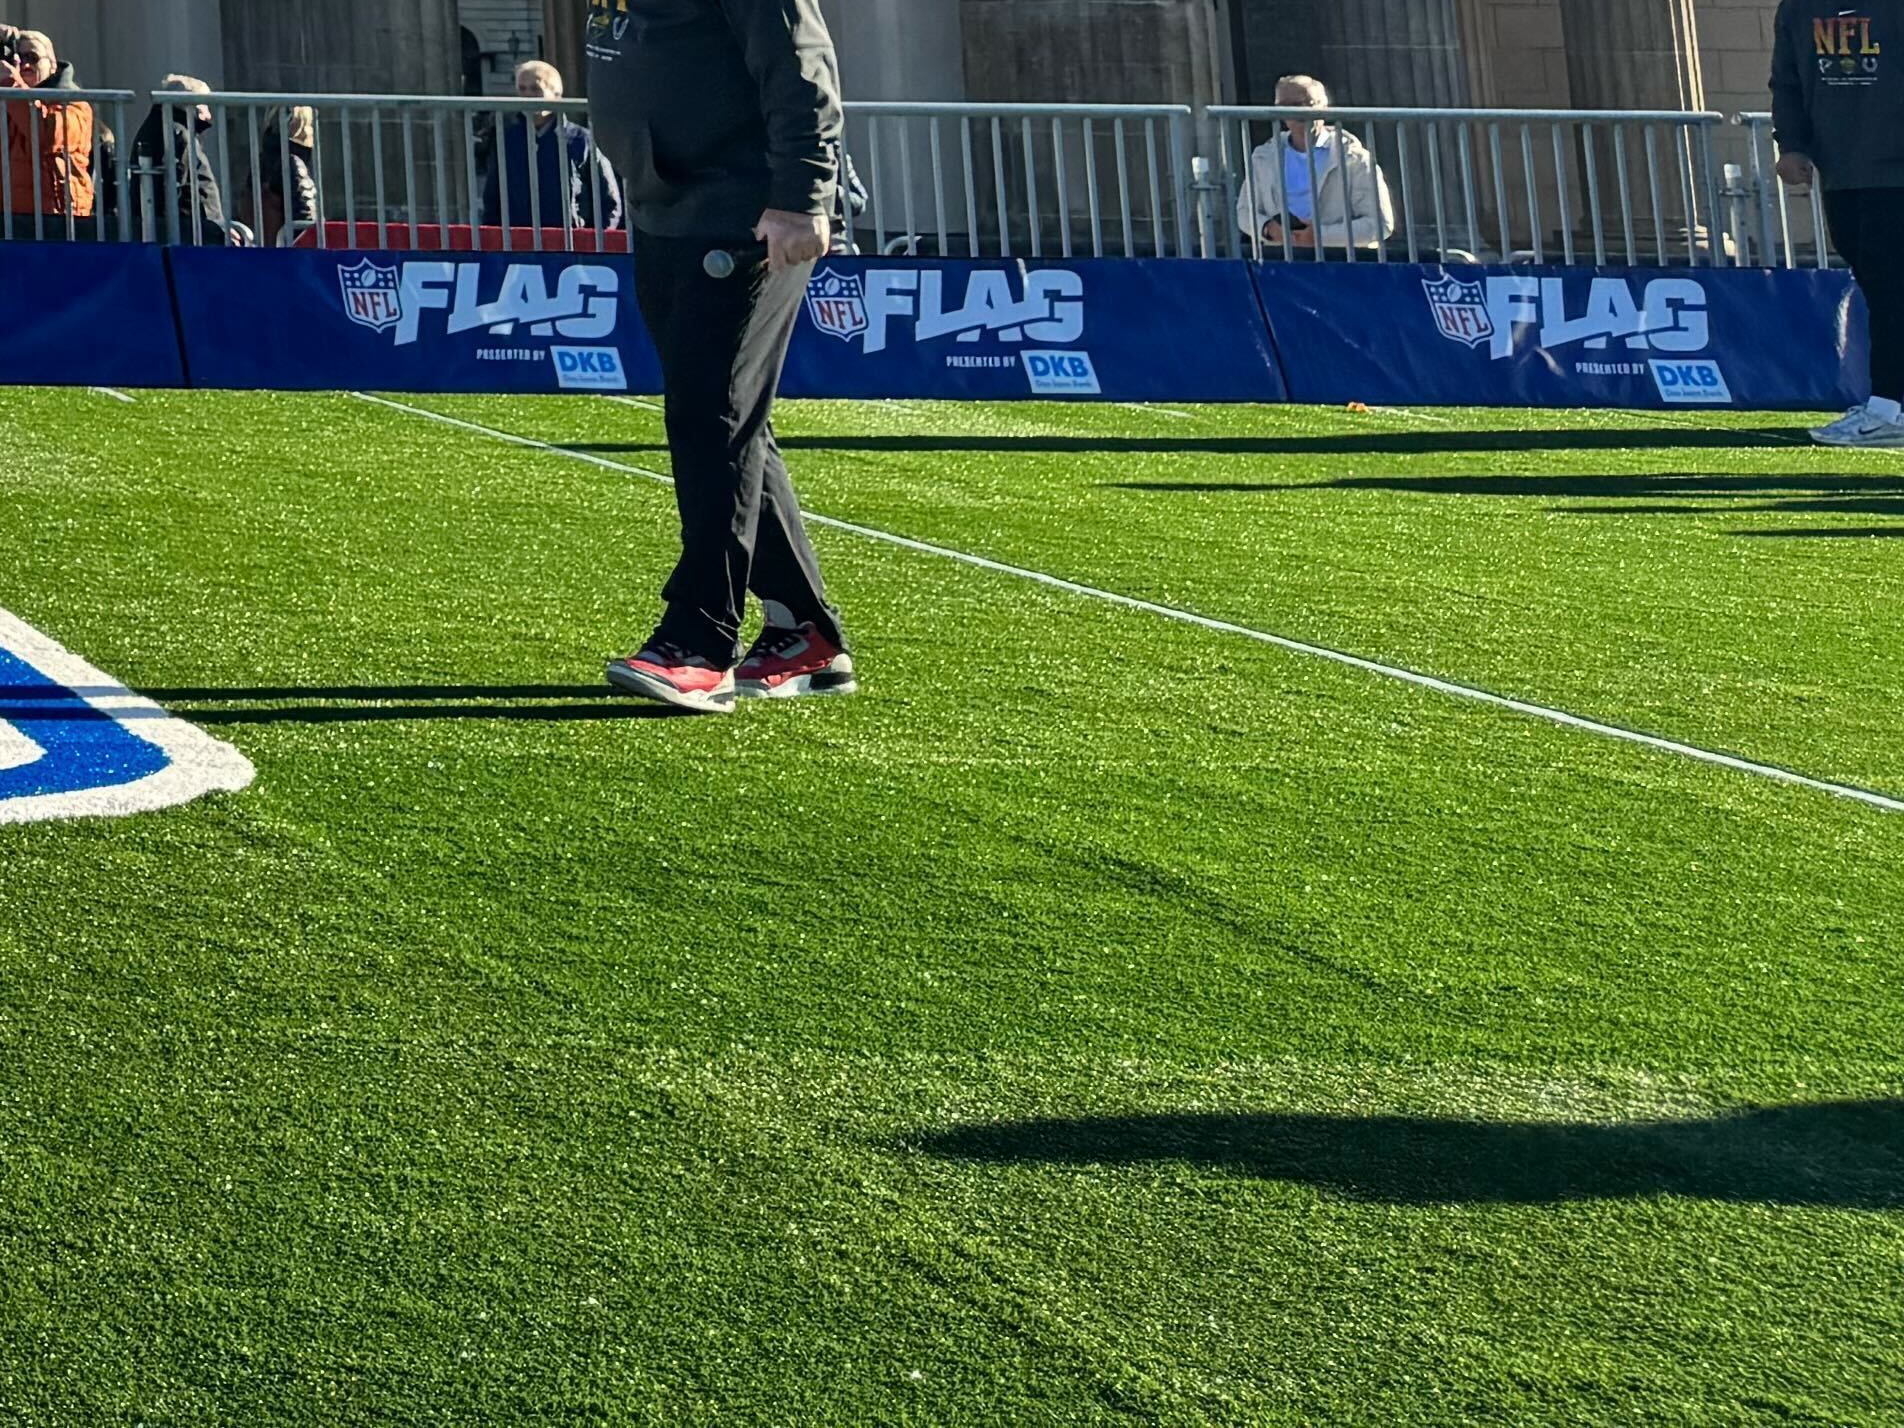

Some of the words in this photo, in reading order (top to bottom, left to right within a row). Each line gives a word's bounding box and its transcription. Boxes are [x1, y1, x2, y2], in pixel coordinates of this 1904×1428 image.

[1813, 17, 1881, 55] NFL
[352, 291, 398, 321] NFL
[394, 262, 619, 346] FLAG
[816, 300, 864, 330] NFL
[863, 269, 1084, 354] FLAG
[1442, 305, 1490, 338] NFL
[1486, 276, 1709, 360] FLAG
[558, 351, 616, 374] DKB
[1028, 356, 1089, 378] DKB
[1657, 365, 1719, 387] DKB
